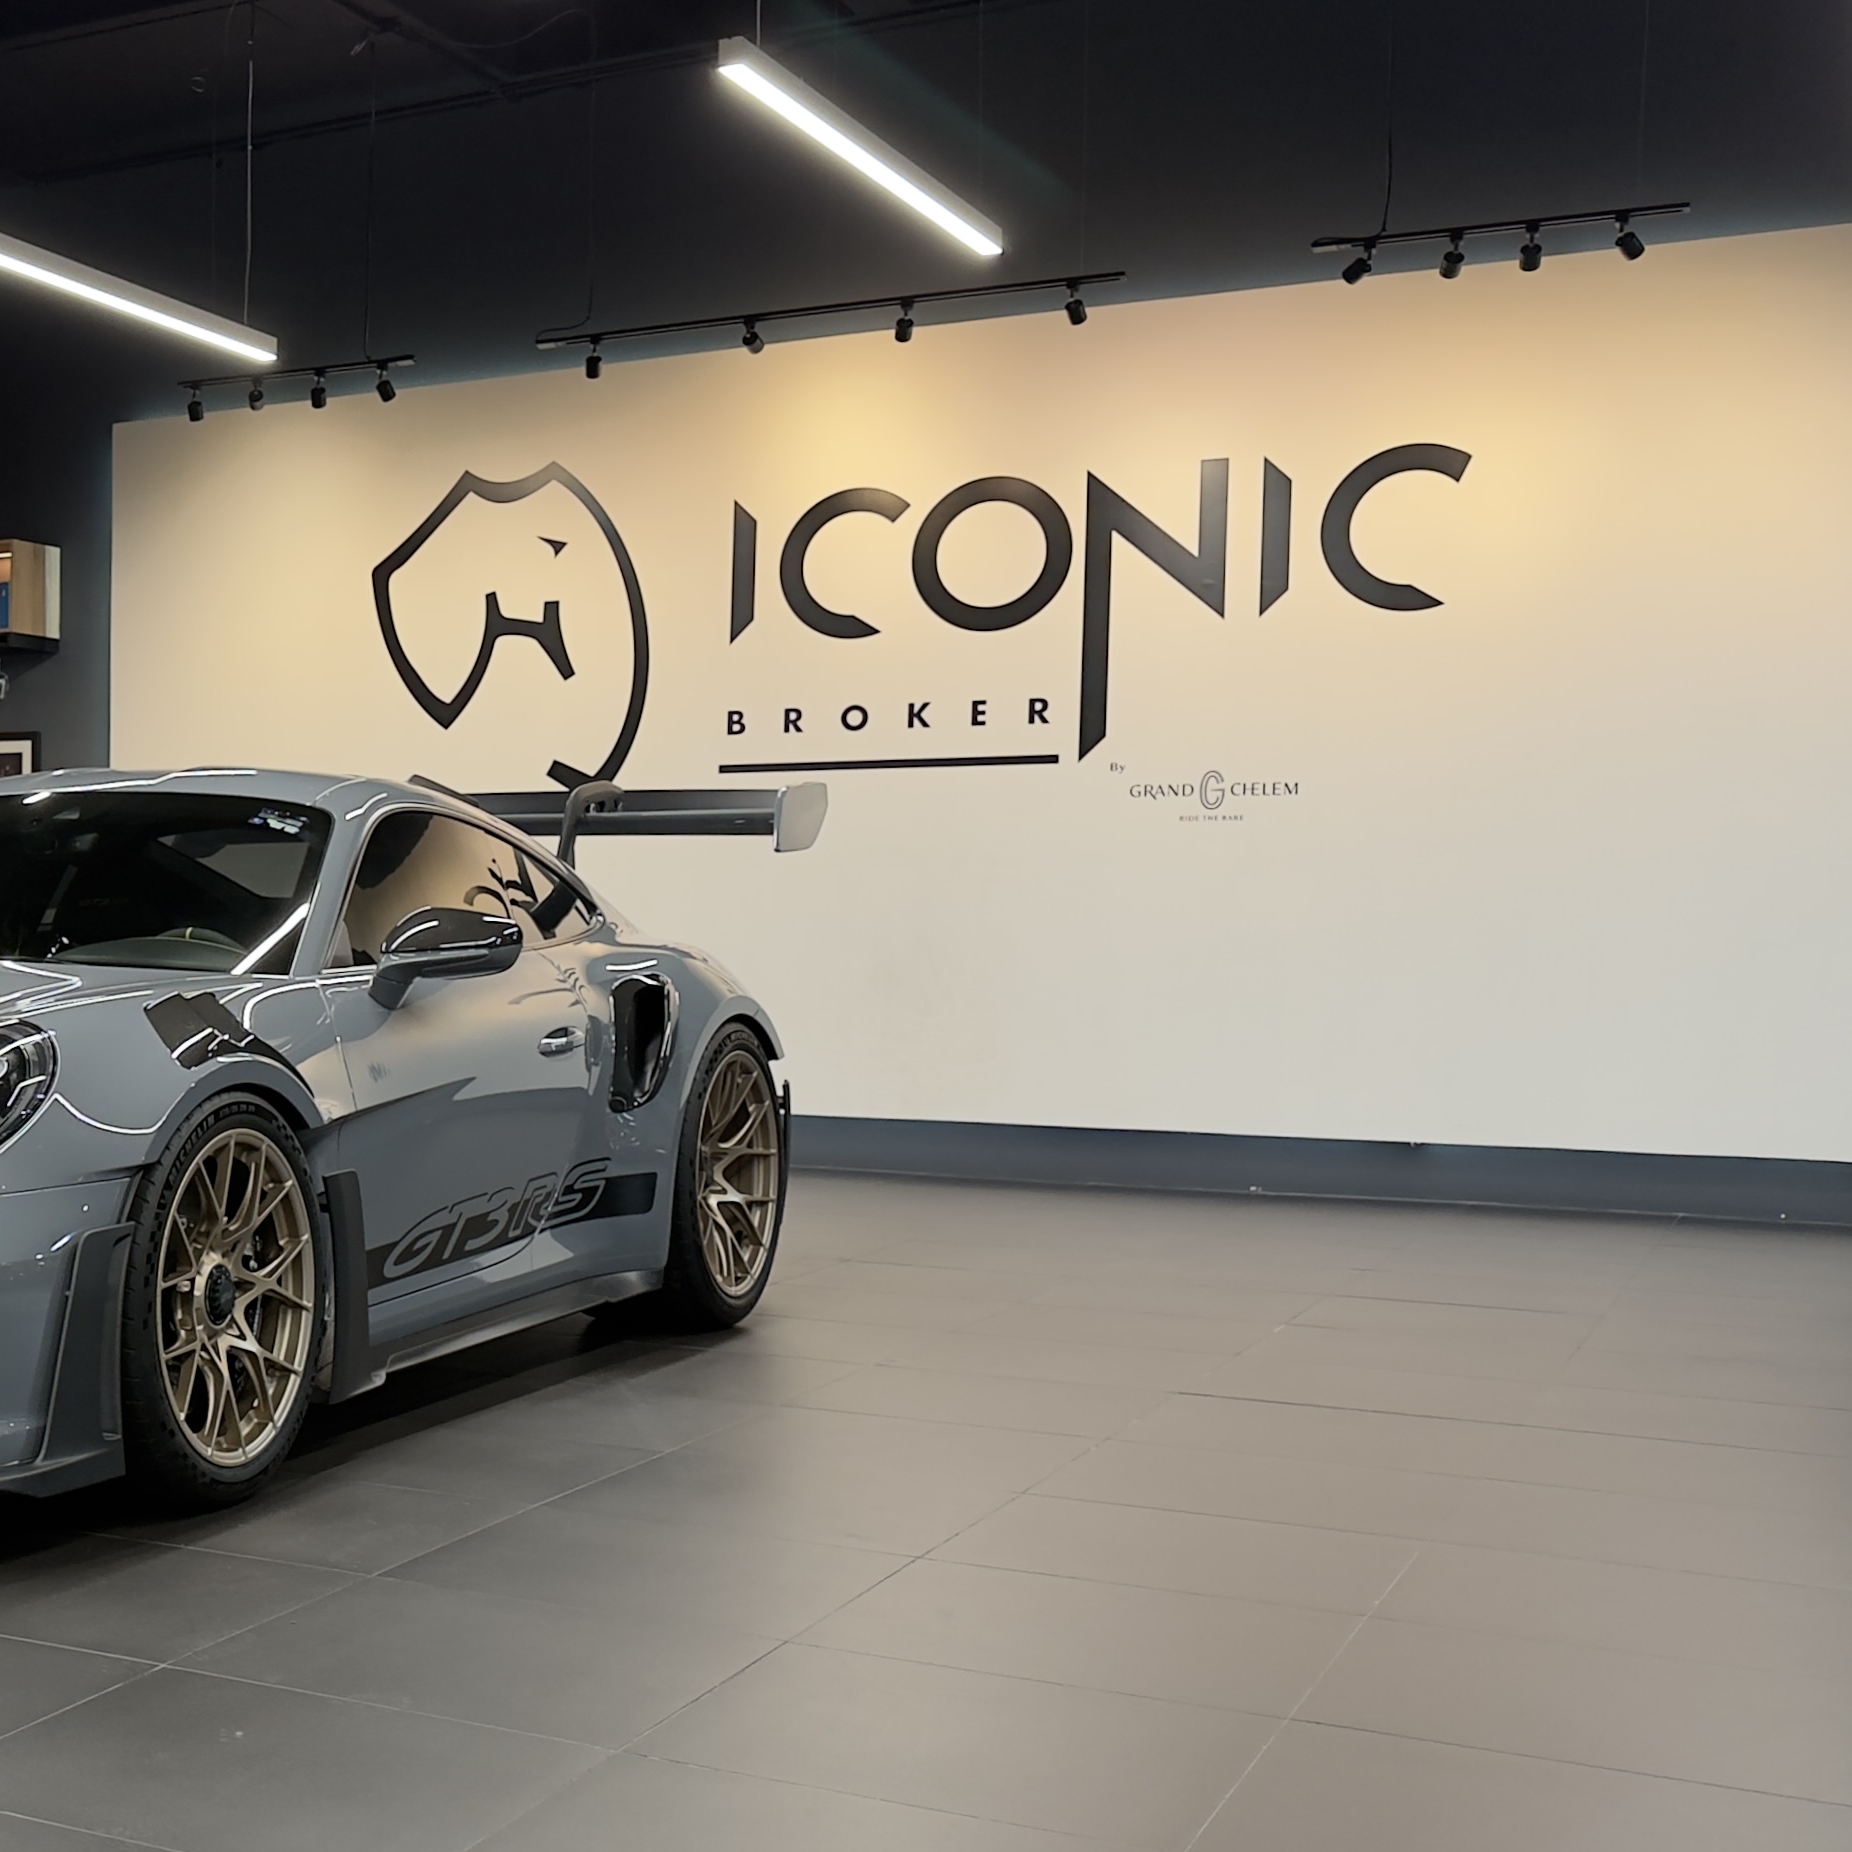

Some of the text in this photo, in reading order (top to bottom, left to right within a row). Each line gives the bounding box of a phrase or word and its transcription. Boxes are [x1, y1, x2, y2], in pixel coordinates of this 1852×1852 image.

[730, 443, 1473, 762] ICONIC
[725, 697, 1051, 736] BROKER
[1109, 761, 1126, 774] By
[1129, 784, 1195, 801] GRAND
[1230, 782, 1300, 797] CHELEM
[168, 1114, 215, 1187] MICHELIN
